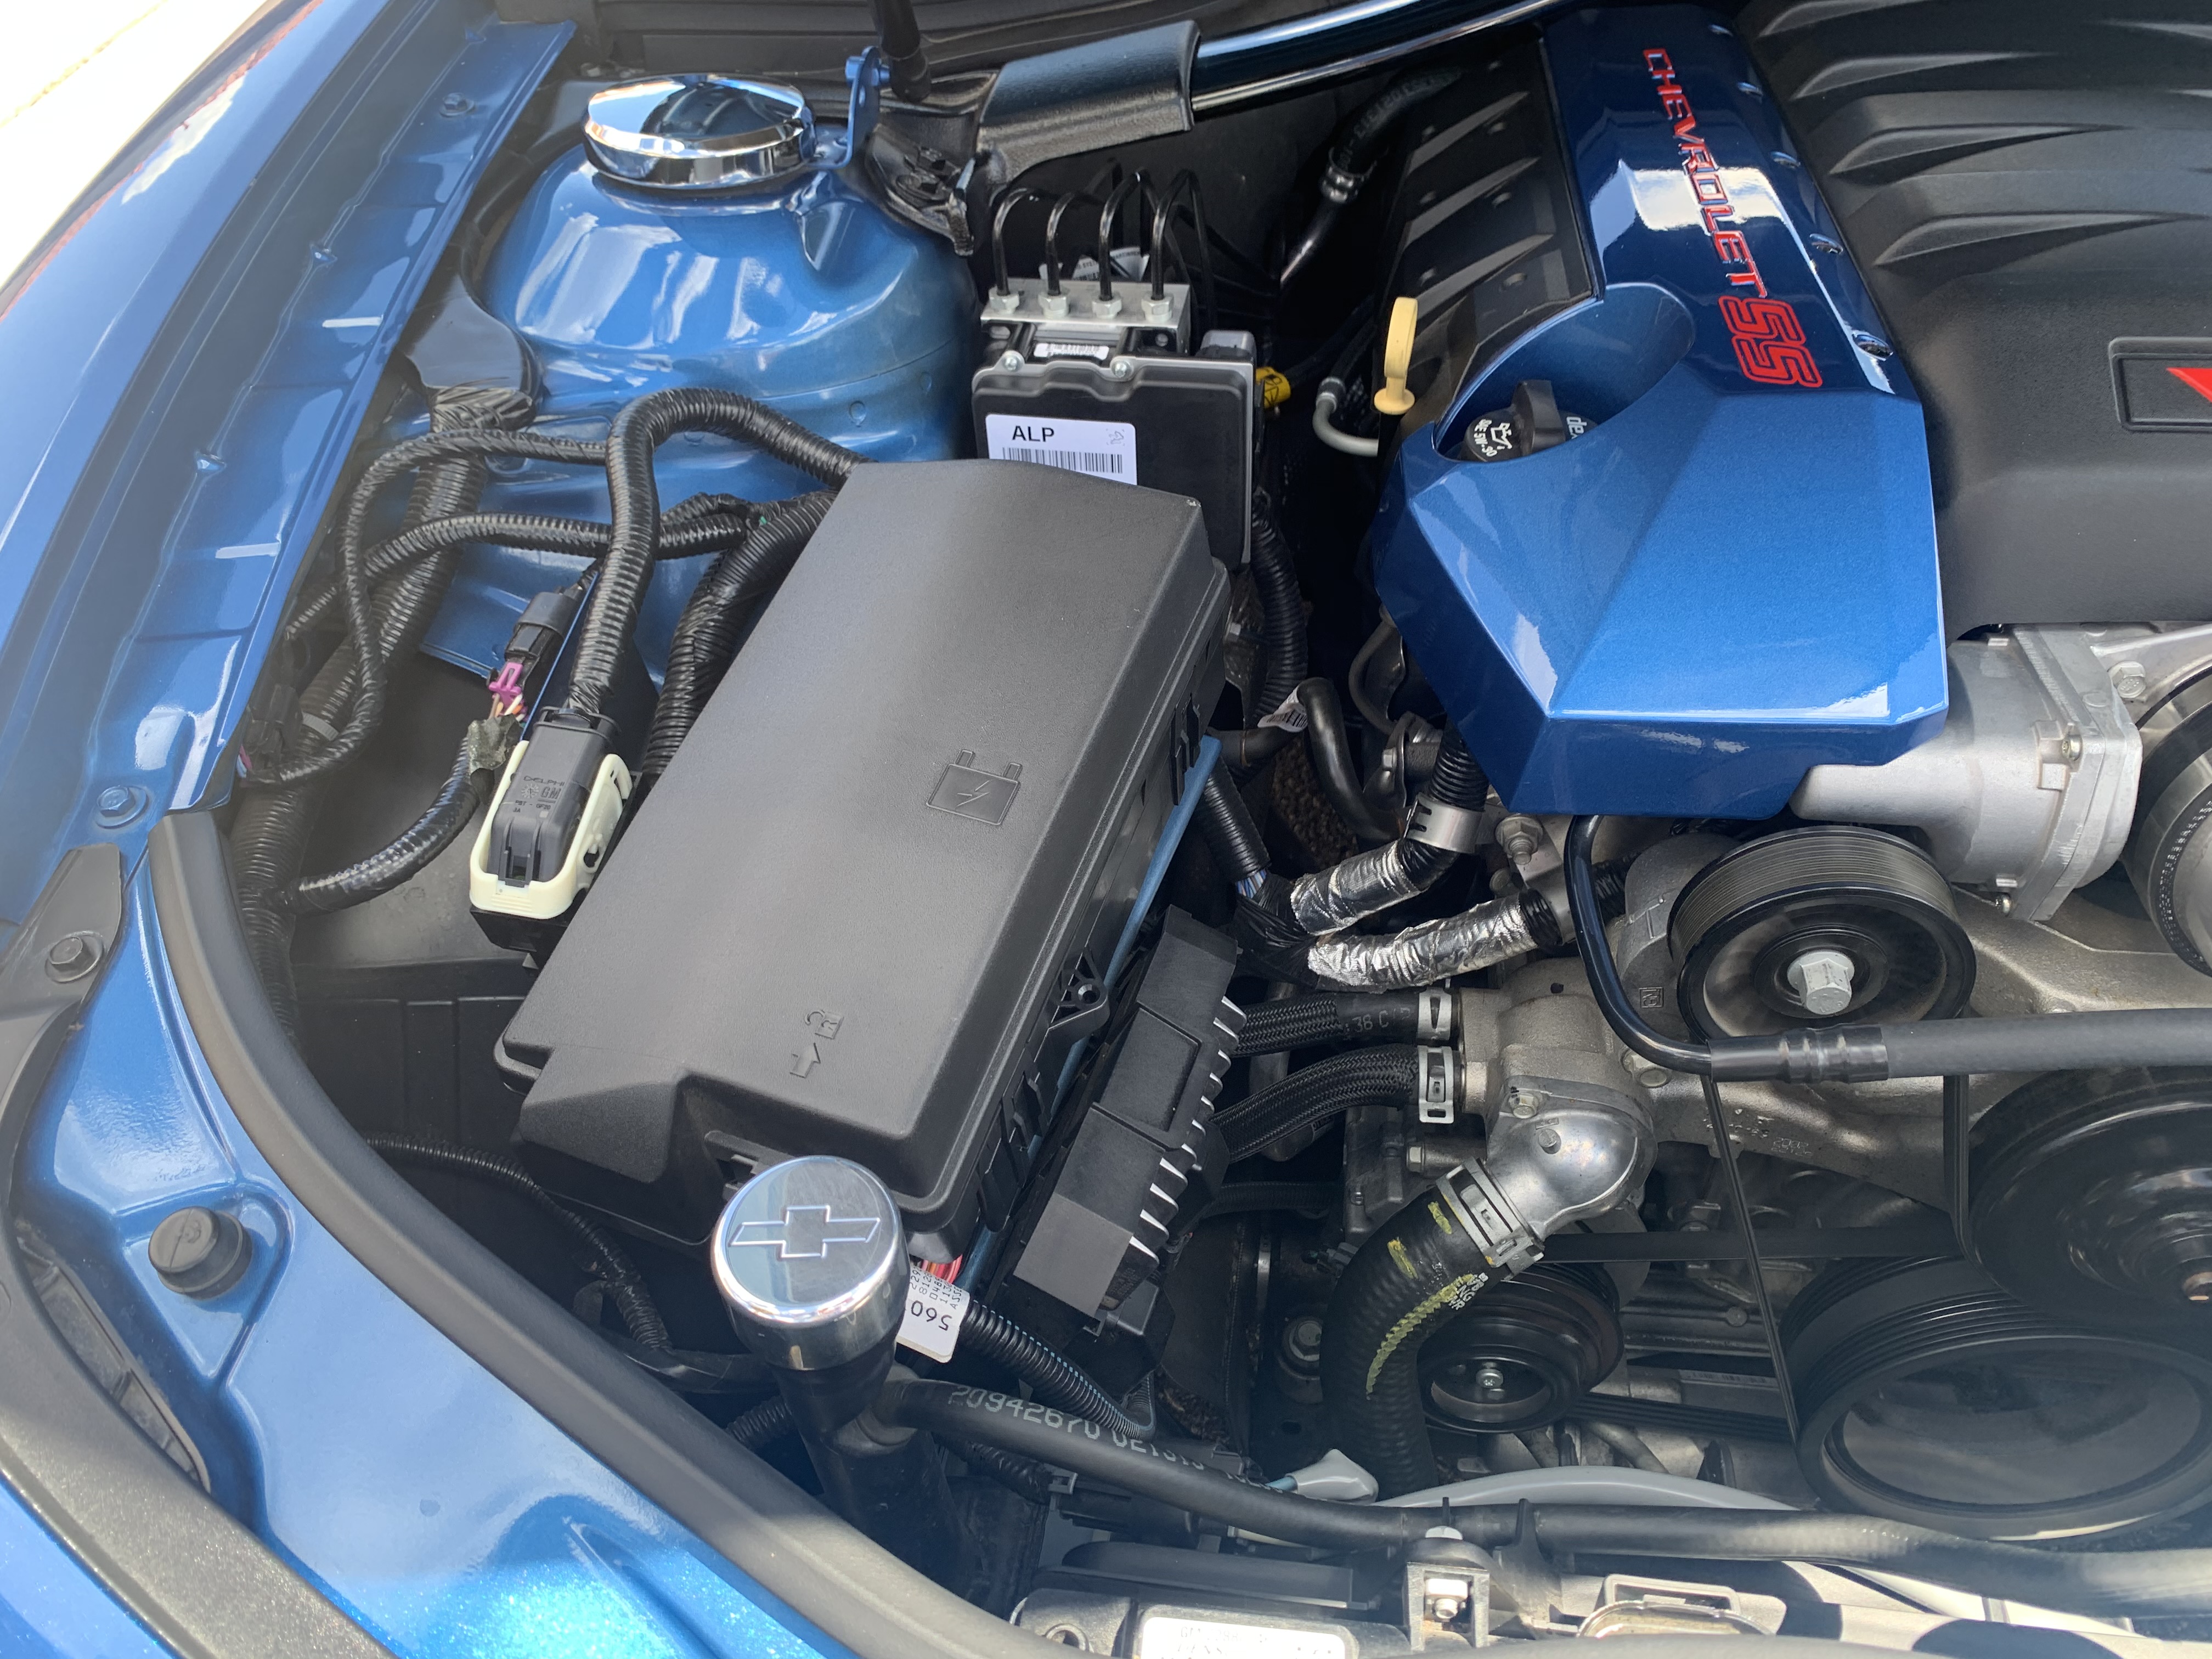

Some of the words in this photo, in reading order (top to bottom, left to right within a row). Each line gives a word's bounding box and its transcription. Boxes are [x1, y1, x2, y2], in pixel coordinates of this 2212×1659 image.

[1643, 48, 1768, 298] CHEVROLET
[1718, 295, 1823, 388] SS
[1012, 425, 1055, 443] ALP
[540, 786, 561, 799] GM
